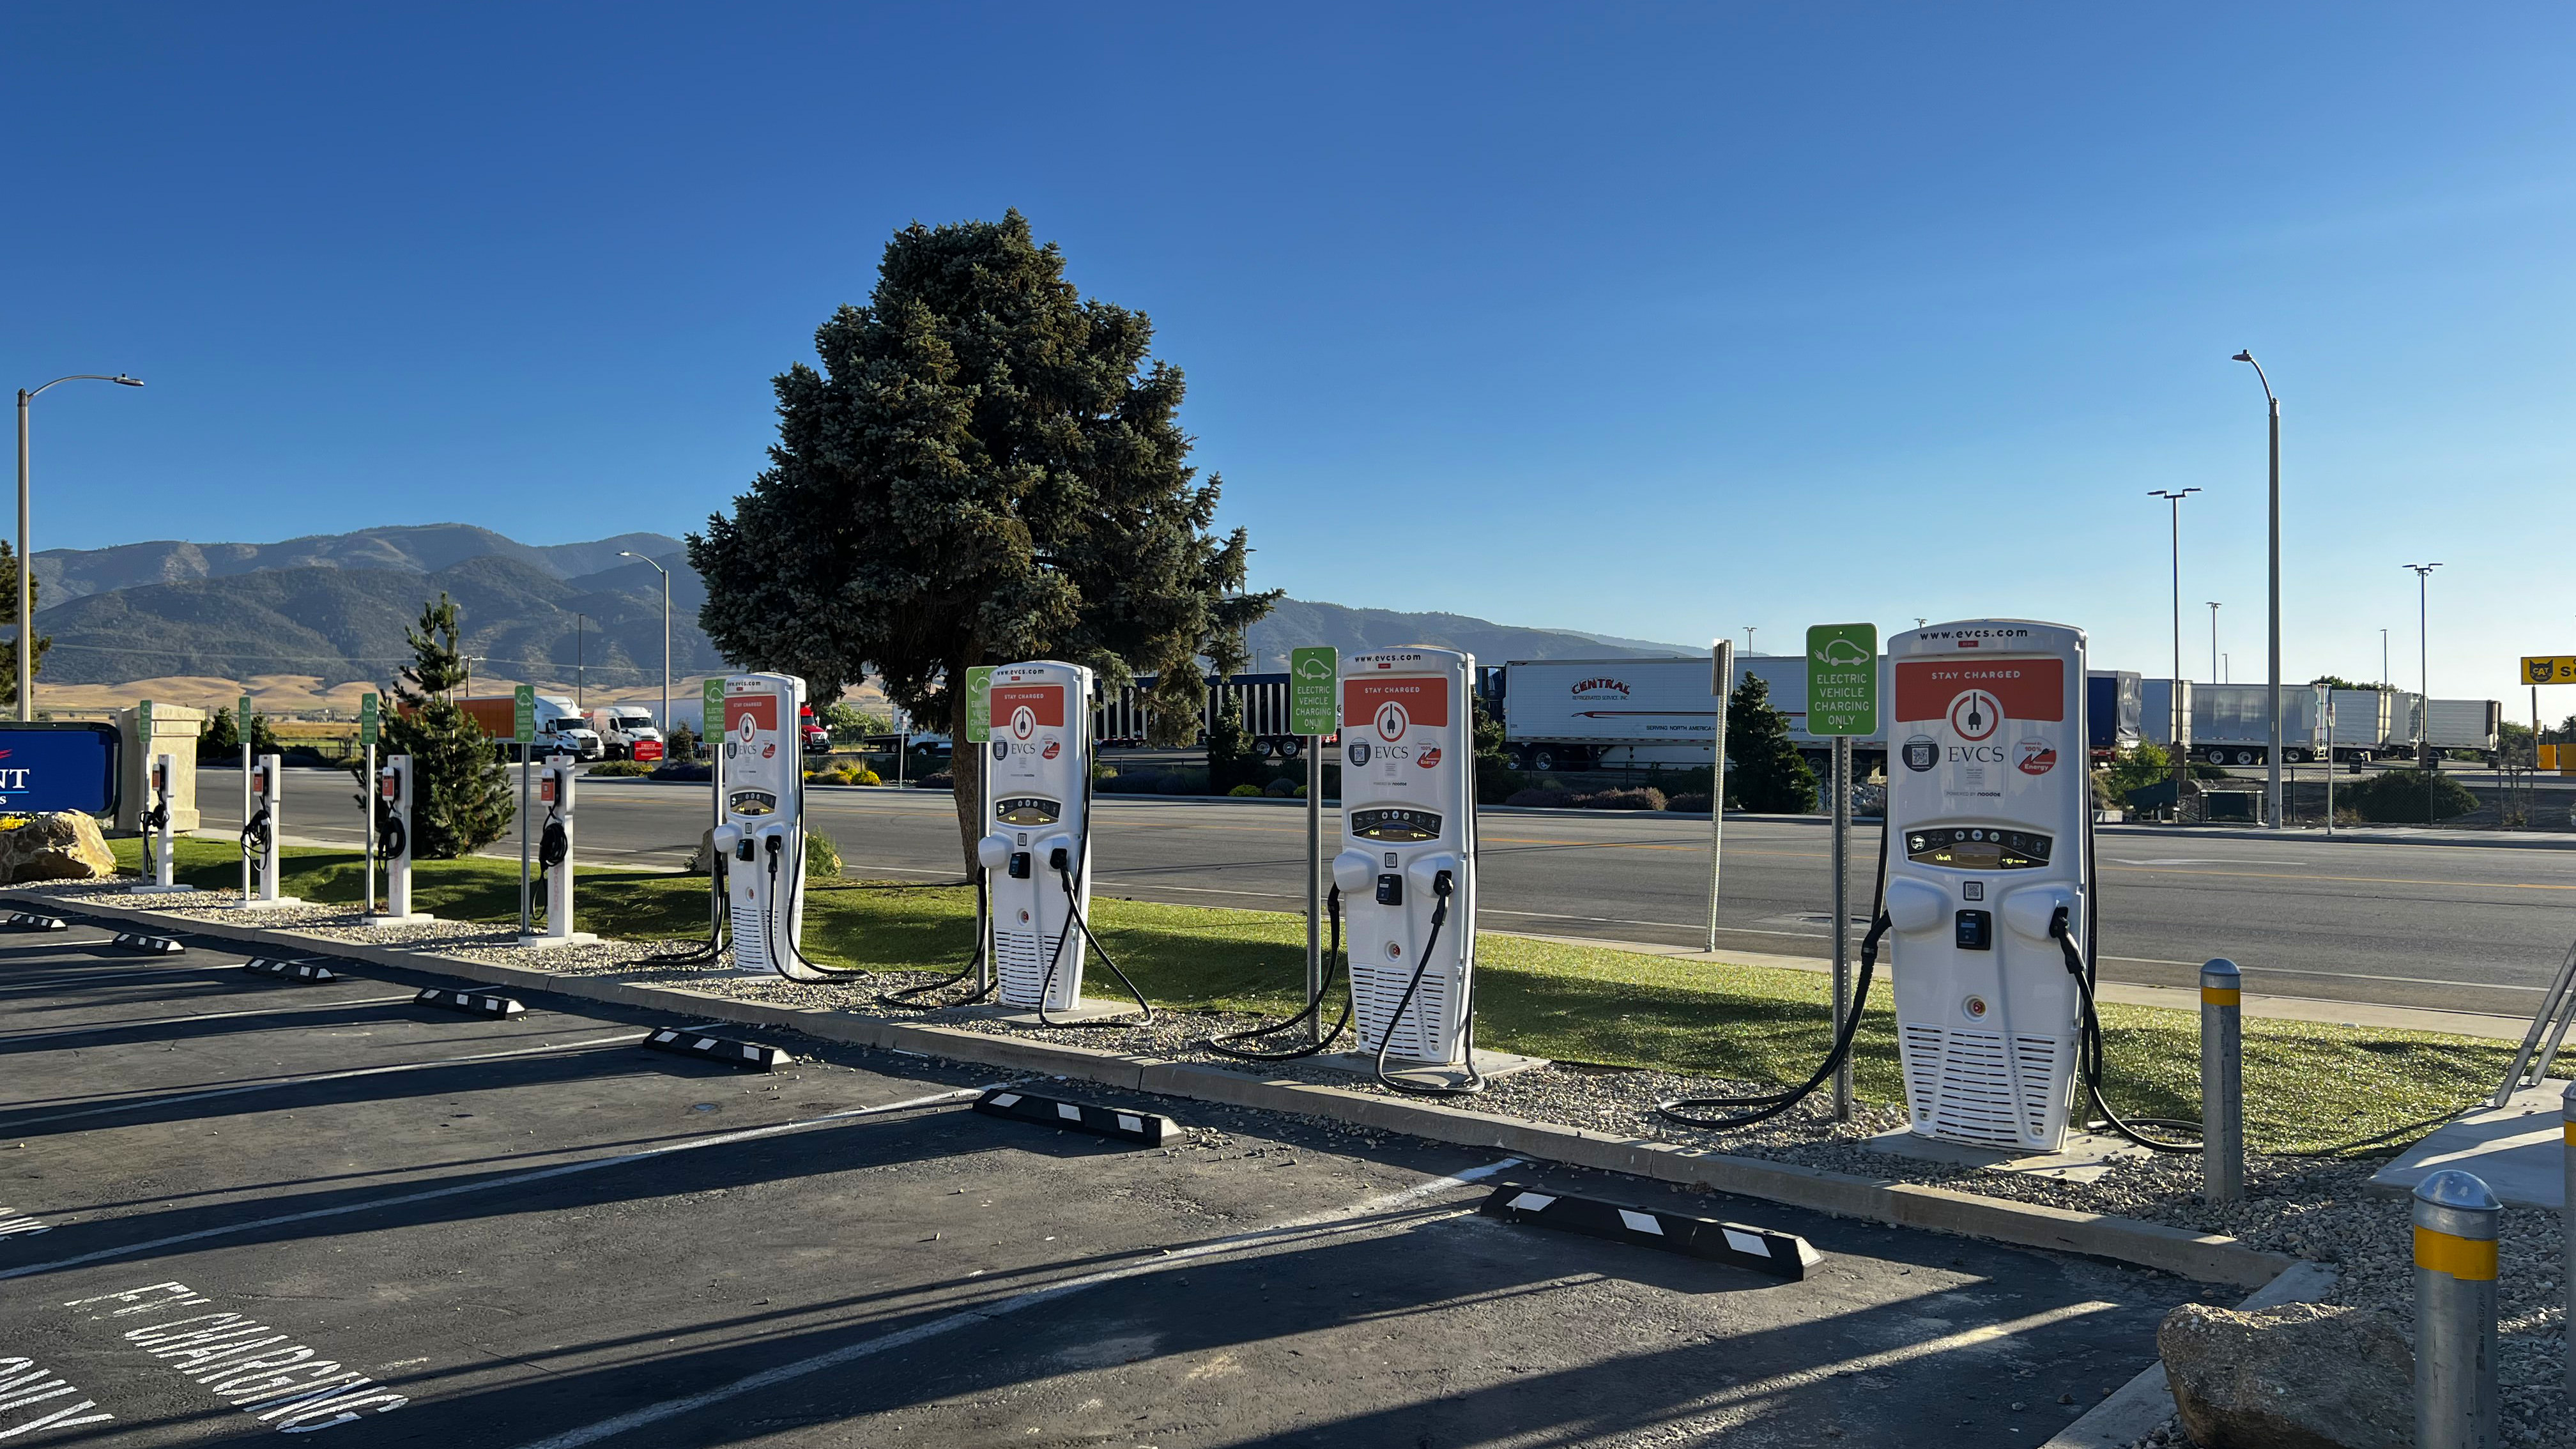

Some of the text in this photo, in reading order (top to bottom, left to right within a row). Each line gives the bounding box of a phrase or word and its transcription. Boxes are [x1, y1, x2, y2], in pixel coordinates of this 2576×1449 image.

[1920, 629, 2028, 640] www.evcs.com
[1355, 654, 1421, 663] www.evcs.com
[1931, 671, 2020, 680] STAY CHARGED
[2533, 667, 2549, 675] CAT
[1817, 673, 1867, 684] ELECTRIC
[1298, 686, 1330, 694] ELECTRIC
[1571, 677, 1630, 695] CENTRAL
[1820, 687, 1864, 698] VEHICLE
[1299, 696, 1328, 705] VEHICLE
[1296, 707, 1331, 716] CHARGING
[1814, 702, 1869, 711] CHARGING
[1304, 718, 1322, 727] ONLY
[1828, 715, 1855, 725] ONLY
[739, 744, 756, 755] EVCS
[1011, 743, 1036, 755] EVCS
[1375, 746, 1409, 759] EVCS
[1949, 746, 2004, 762] EVCS
[2025, 763, 2049, 772] Energy
[125, 1312, 410, 1433] CHARGING
